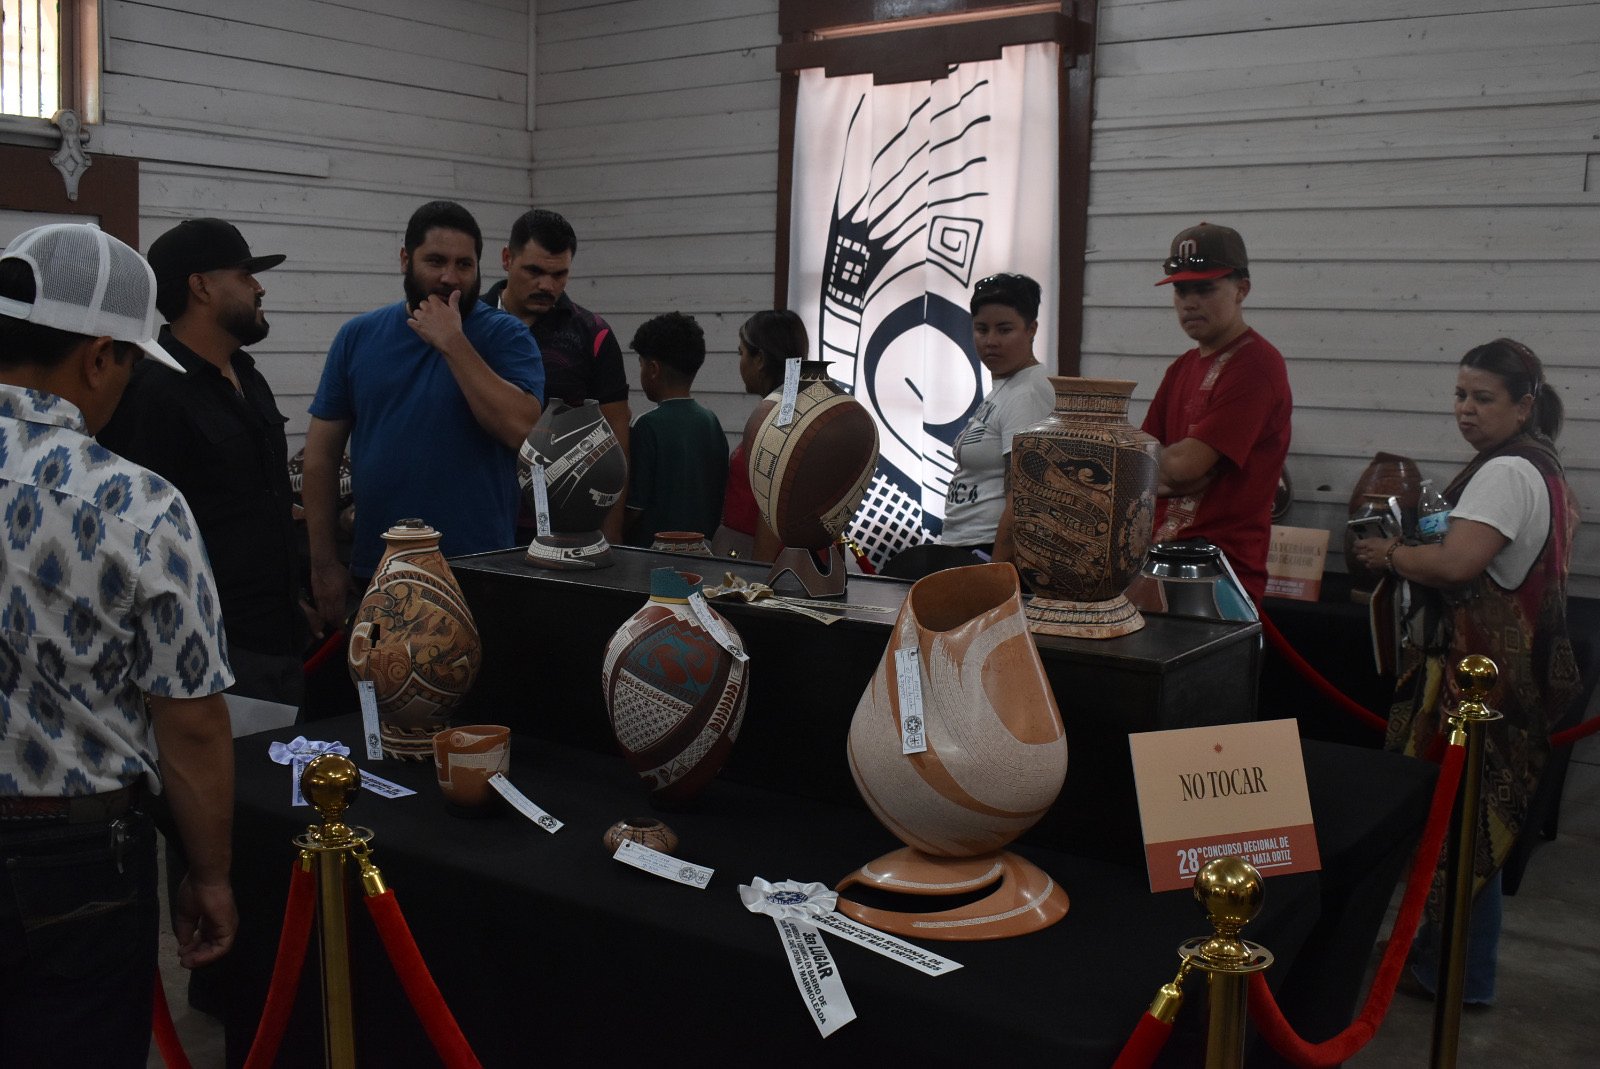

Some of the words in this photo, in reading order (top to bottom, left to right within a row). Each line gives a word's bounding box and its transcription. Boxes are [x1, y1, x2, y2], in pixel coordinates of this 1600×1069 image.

[1178, 773, 1206, 801] NO
[1207, 766, 1268, 798] TOCAR
[1202, 842, 1243, 858] CONCURSO
[1243, 838, 1279, 853] REGIONAL
[1279, 836, 1290, 849] DE
[1252, 853, 1271, 865] MATA
[1271, 850, 1292, 861] ORTIZ
[802, 932, 817, 945] 3ER
[838, 921, 885, 941] CONCURSO
[883, 940, 929, 960] REGIONAL
[928, 958, 945, 966] DE
[808, 945, 834, 981] LUGAR
[854, 933, 869, 941] DE
[866, 939, 891, 951] MATA
[890, 949, 918, 962] ORTIZ
[916, 960, 943, 971] 2025
[804, 961, 813, 970] EN
[807, 969, 822, 995] BARRO
[799, 970, 827, 1025] MARMOLEADA
[817, 995, 828, 1008] DE
